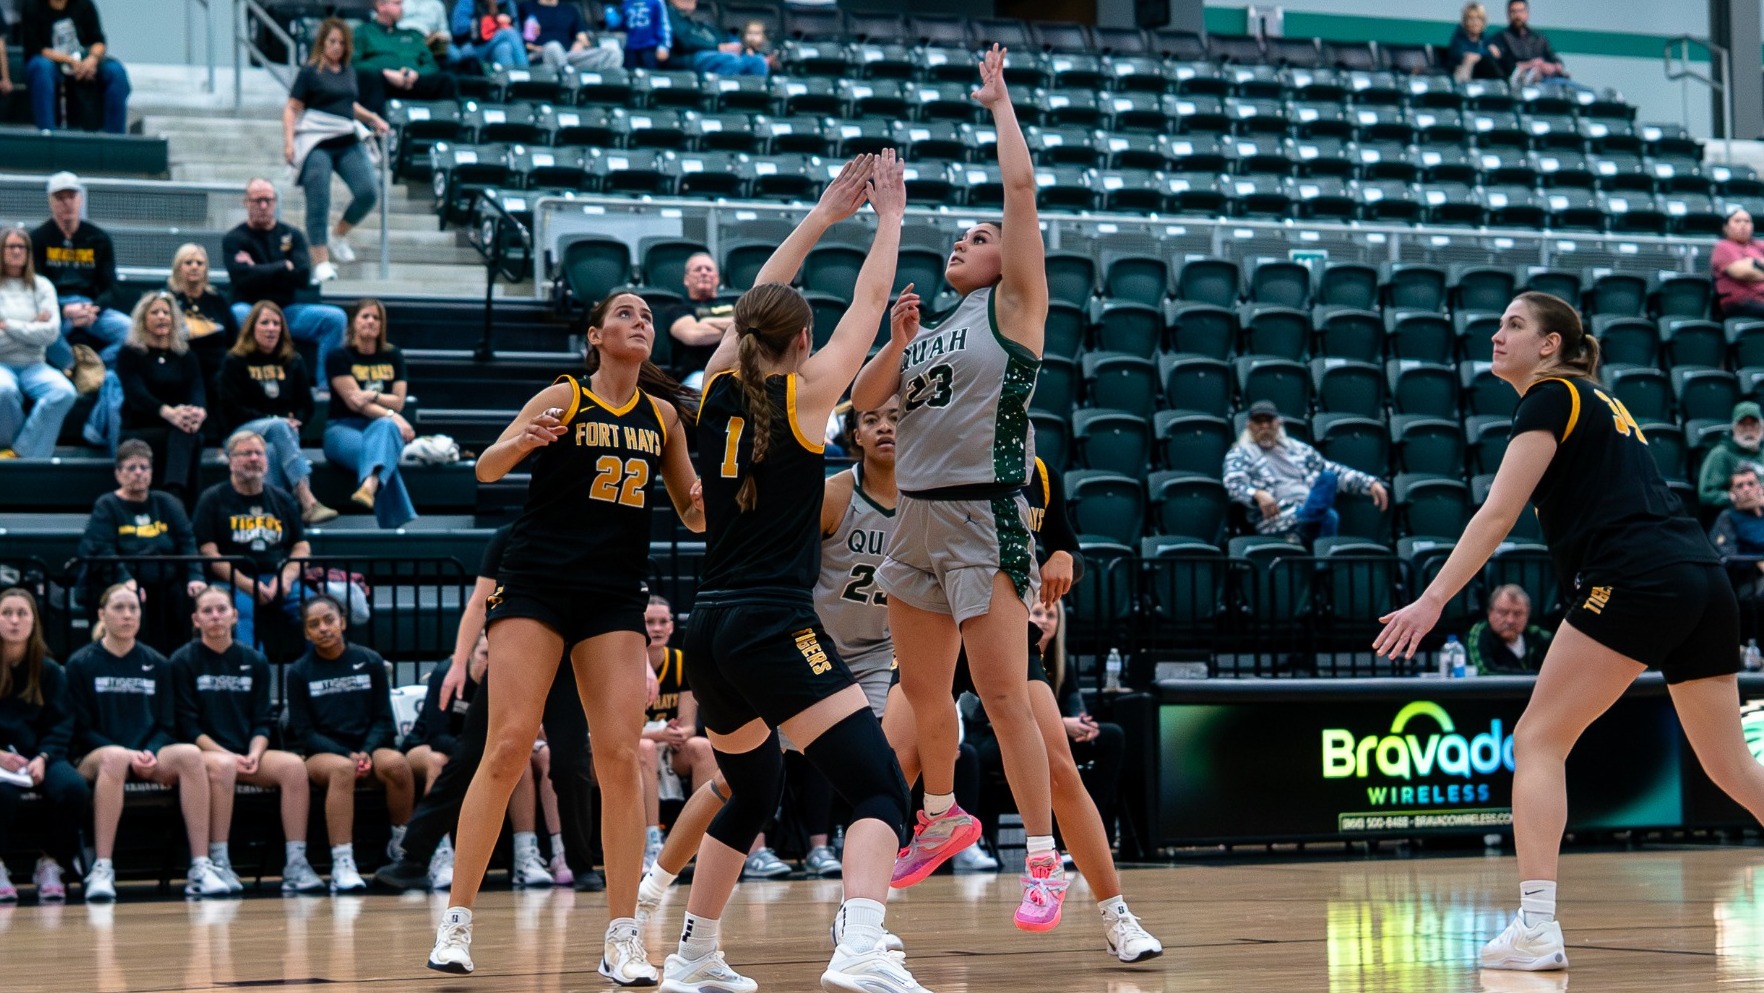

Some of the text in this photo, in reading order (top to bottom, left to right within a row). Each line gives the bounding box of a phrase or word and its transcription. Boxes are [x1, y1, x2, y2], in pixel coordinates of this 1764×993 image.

[905, 362, 955, 412] 23
[575, 421, 620, 448] FORT
[720, 416, 745, 479] 1
[589, 455, 649, 509] 22
[791, 627, 833, 676] TIGERS
[1367, 783, 1490, 805] WIRELESS
